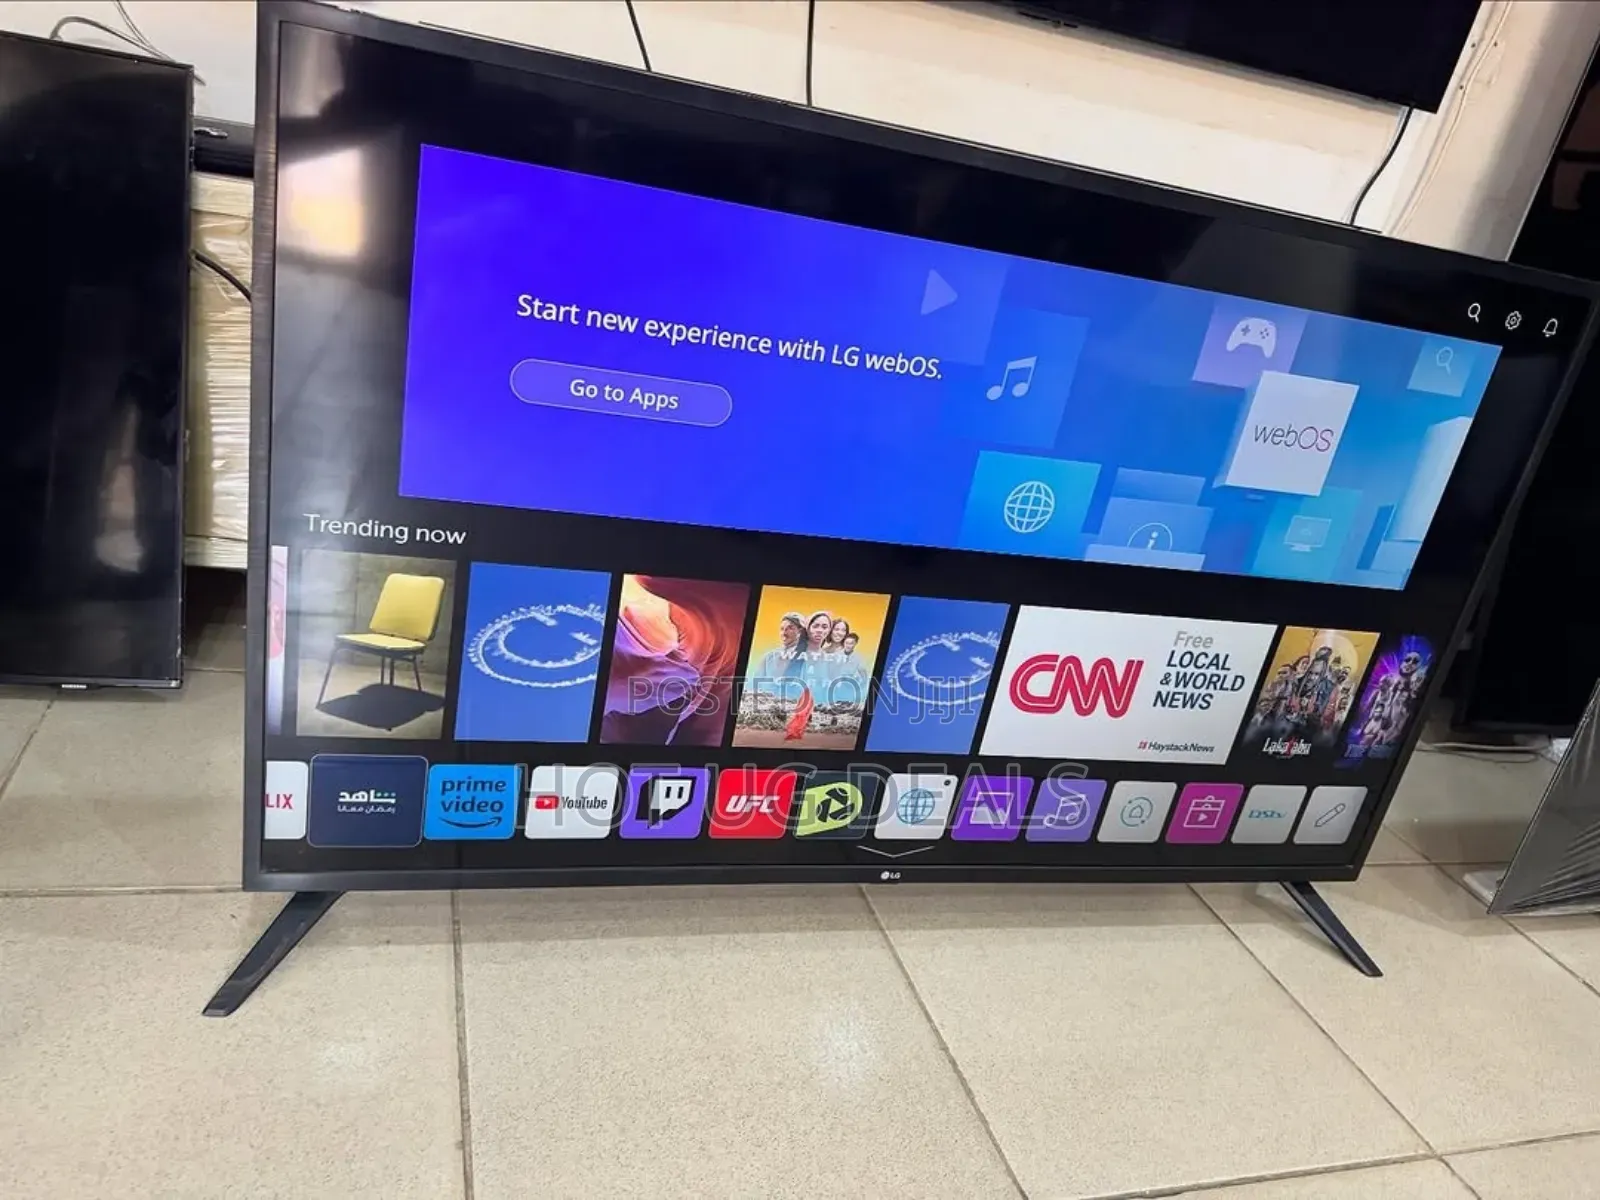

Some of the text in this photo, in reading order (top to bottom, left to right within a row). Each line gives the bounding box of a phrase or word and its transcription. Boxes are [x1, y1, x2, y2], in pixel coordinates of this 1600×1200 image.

[516, 294, 943, 380] Start new experience with LG webOS.
[570, 379, 680, 412] Go to Apps
[1254, 424, 1334, 452] webOS
[302, 513, 467, 545] Trending now
[1173, 630, 1215, 649] Free
[1166, 649, 1232, 671] LOCAL
[1008, 654, 1145, 719] CNN
[1152, 690, 1214, 711] NEWS
[440, 776, 507, 795] prime
[440, 796, 504, 813] video
[560, 796, 608, 811] YouTube
[725, 794, 780, 813] UFC
